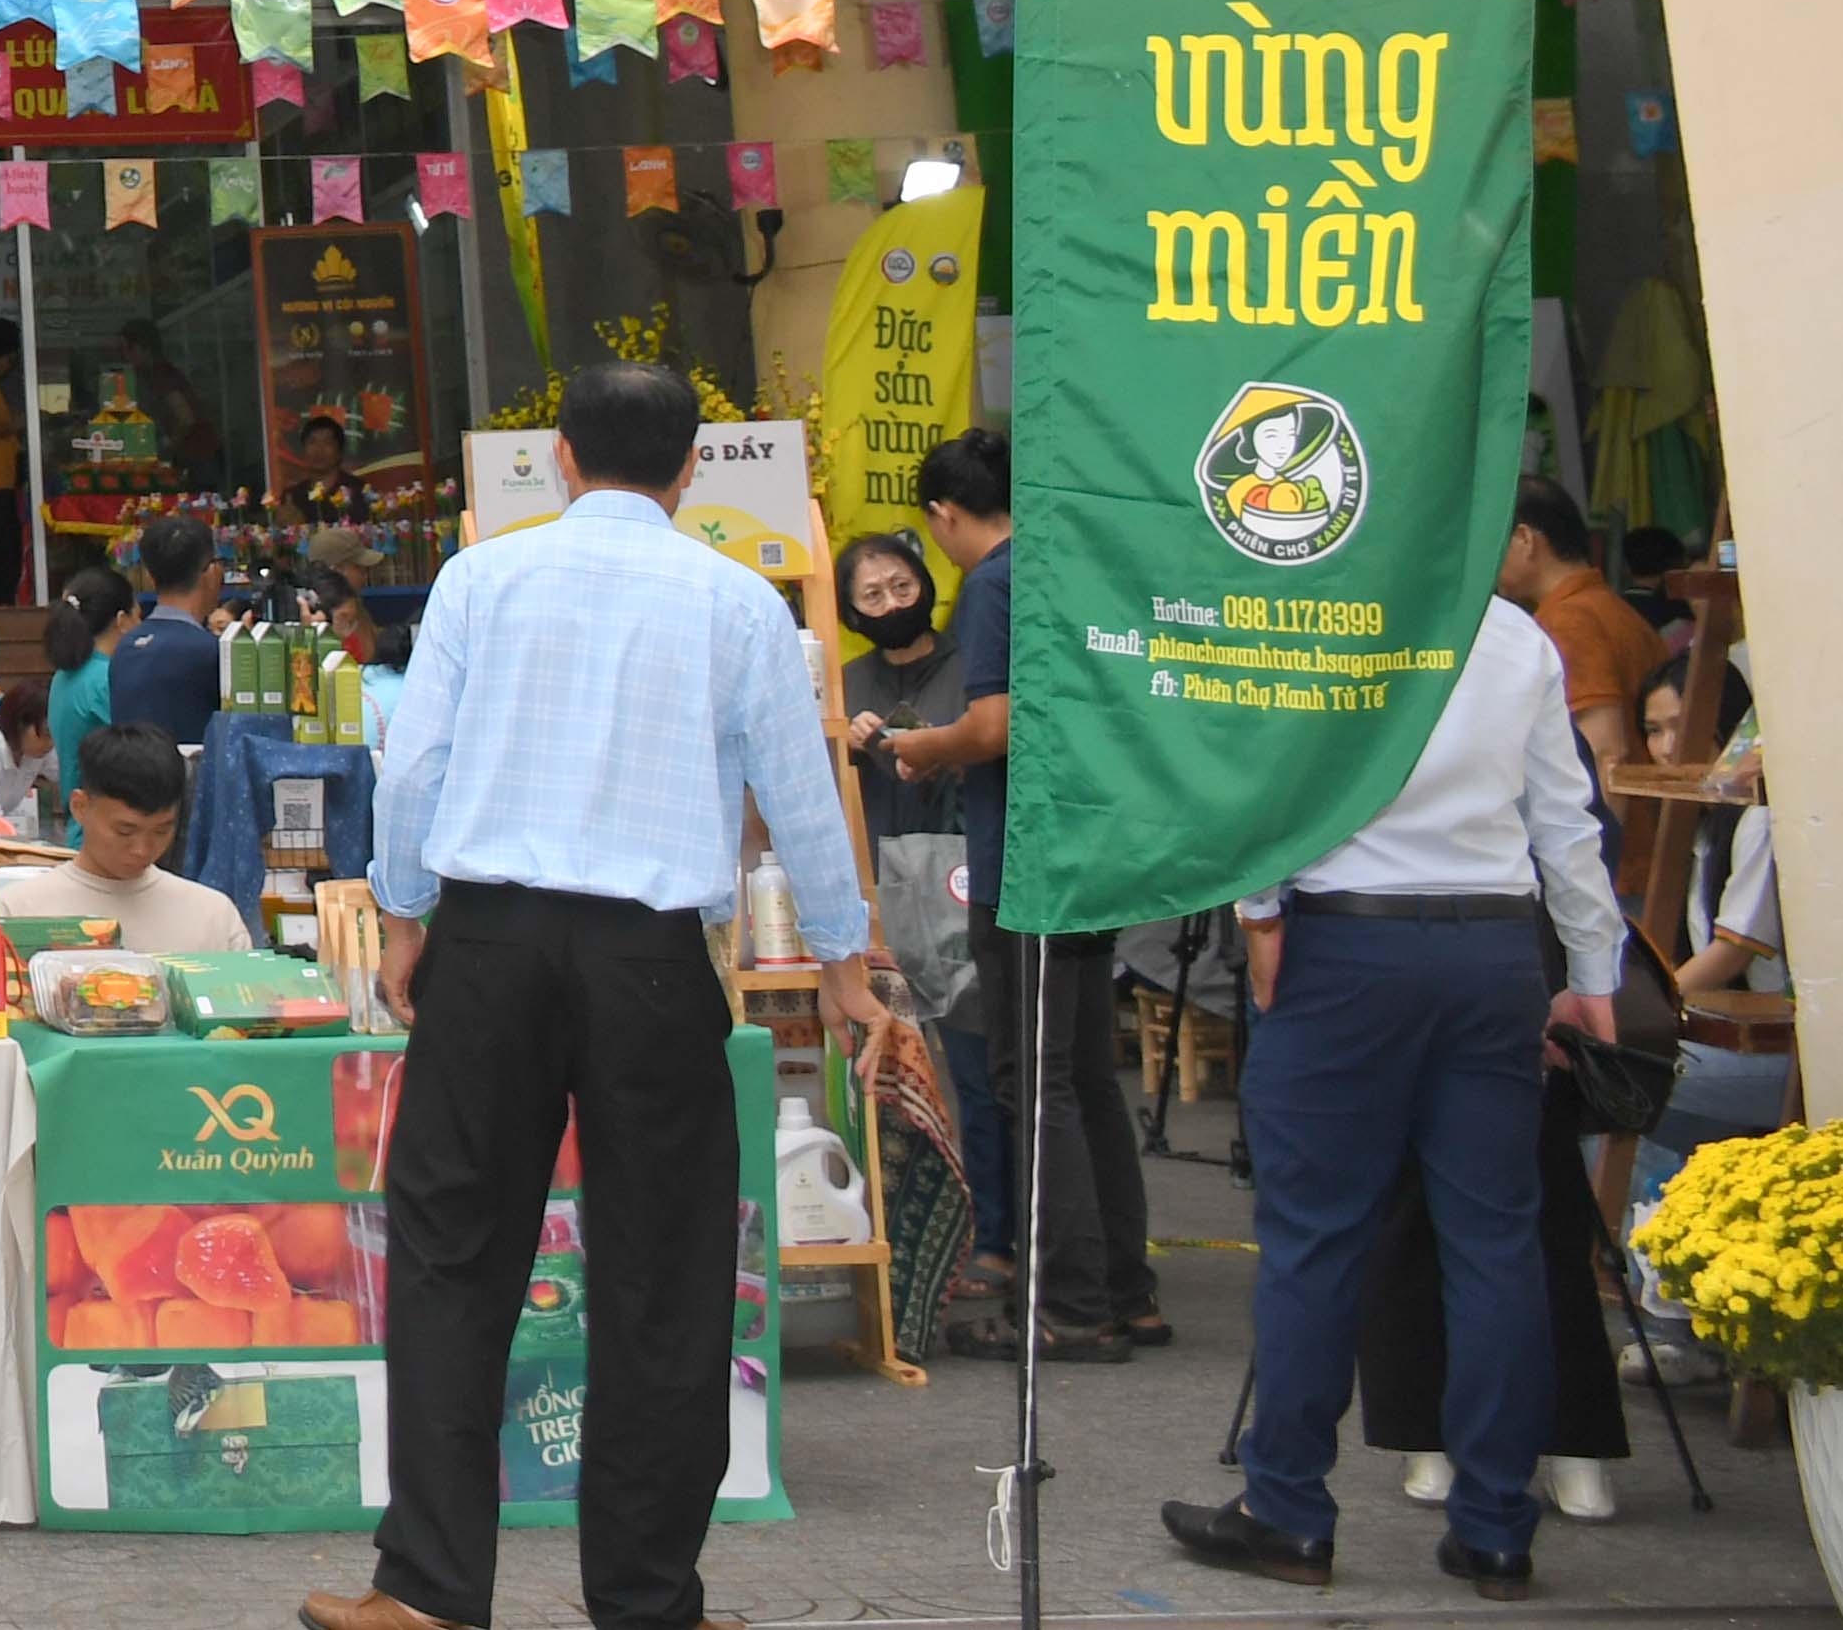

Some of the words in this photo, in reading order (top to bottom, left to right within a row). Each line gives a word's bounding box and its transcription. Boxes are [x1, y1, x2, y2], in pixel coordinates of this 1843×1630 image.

[1146, 1, 1449, 182] vùng
[1146, 159, 1423, 328] miền
[874, 304, 933, 360] Đặc
[874, 360, 935, 407] sản
[1225, 520, 1269, 554] PHIÊN
[1273, 542, 1310, 559] CHỢ
[1314, 510, 1351, 548] XANH
[1150, 595, 1220, 628] Hotline:
[158, 1147, 222, 1171] Xuân
[229, 1145, 314, 1177] Quỳnh
